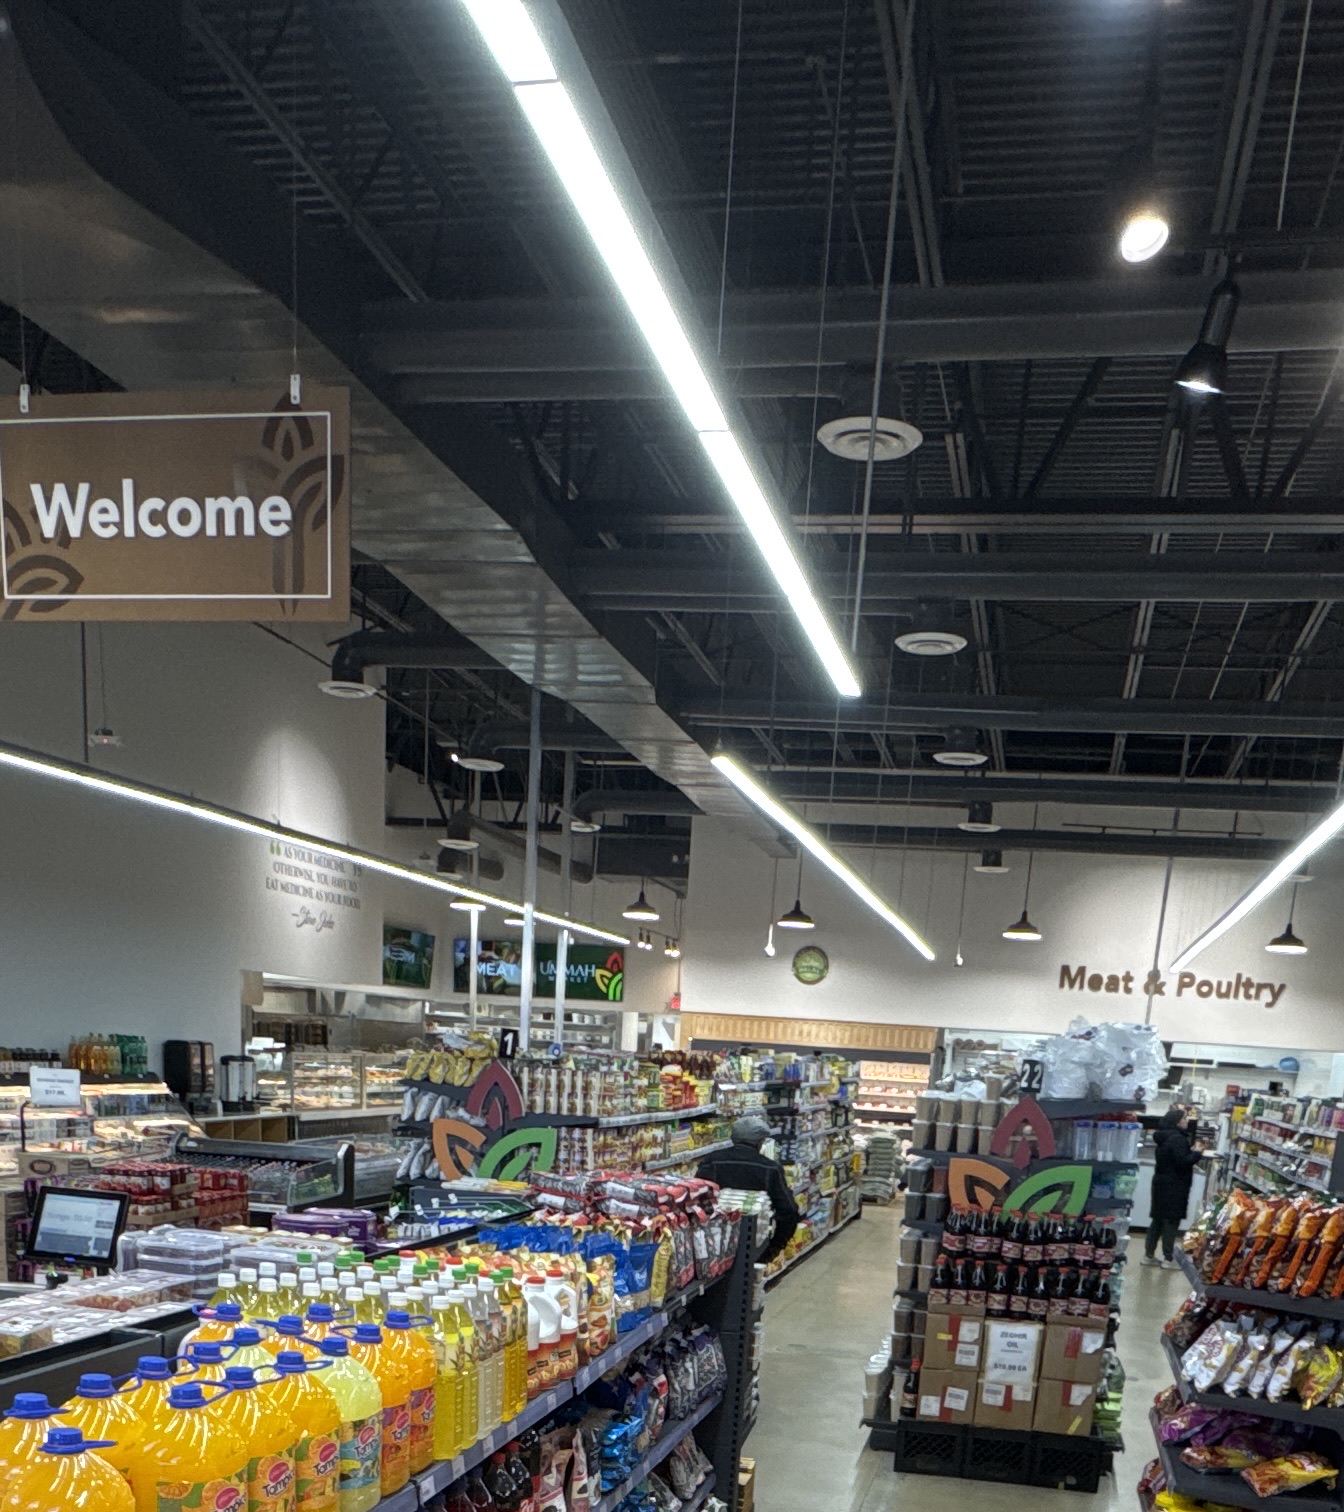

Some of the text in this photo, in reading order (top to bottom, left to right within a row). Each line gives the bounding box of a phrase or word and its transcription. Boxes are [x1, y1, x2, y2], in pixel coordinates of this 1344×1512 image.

[30, 477, 293, 539] Welcome
[475, 962, 519, 978] MEAT
[1058, 964, 1287, 1009] Meat & Poultry
[504, 1031, 514, 1057] 1
